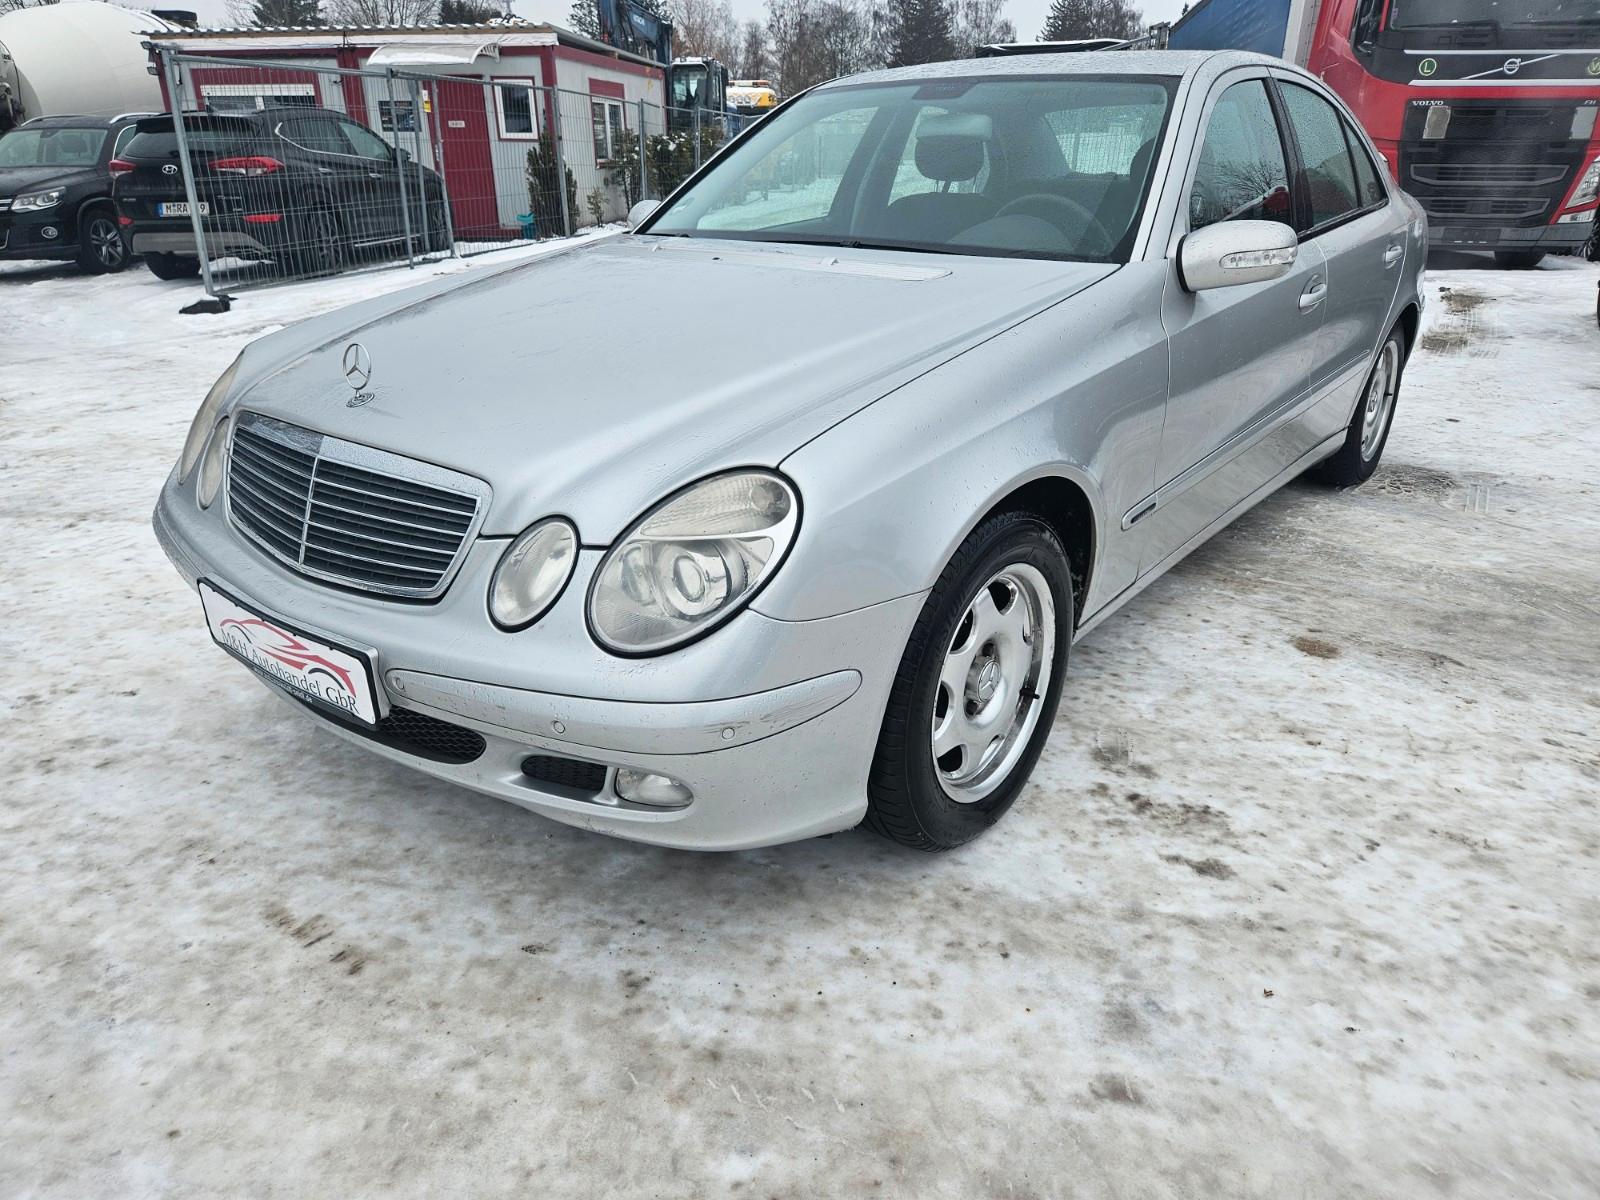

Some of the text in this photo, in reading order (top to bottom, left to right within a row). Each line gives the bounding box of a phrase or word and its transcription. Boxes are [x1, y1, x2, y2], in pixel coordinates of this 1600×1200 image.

[1423, 61, 1431, 72] L
[176, 203, 188, 213] RA
[221, 628, 249, 660] M&H
[251, 649, 322, 697] Autohandel
[325, 686, 360, 715] GbR
